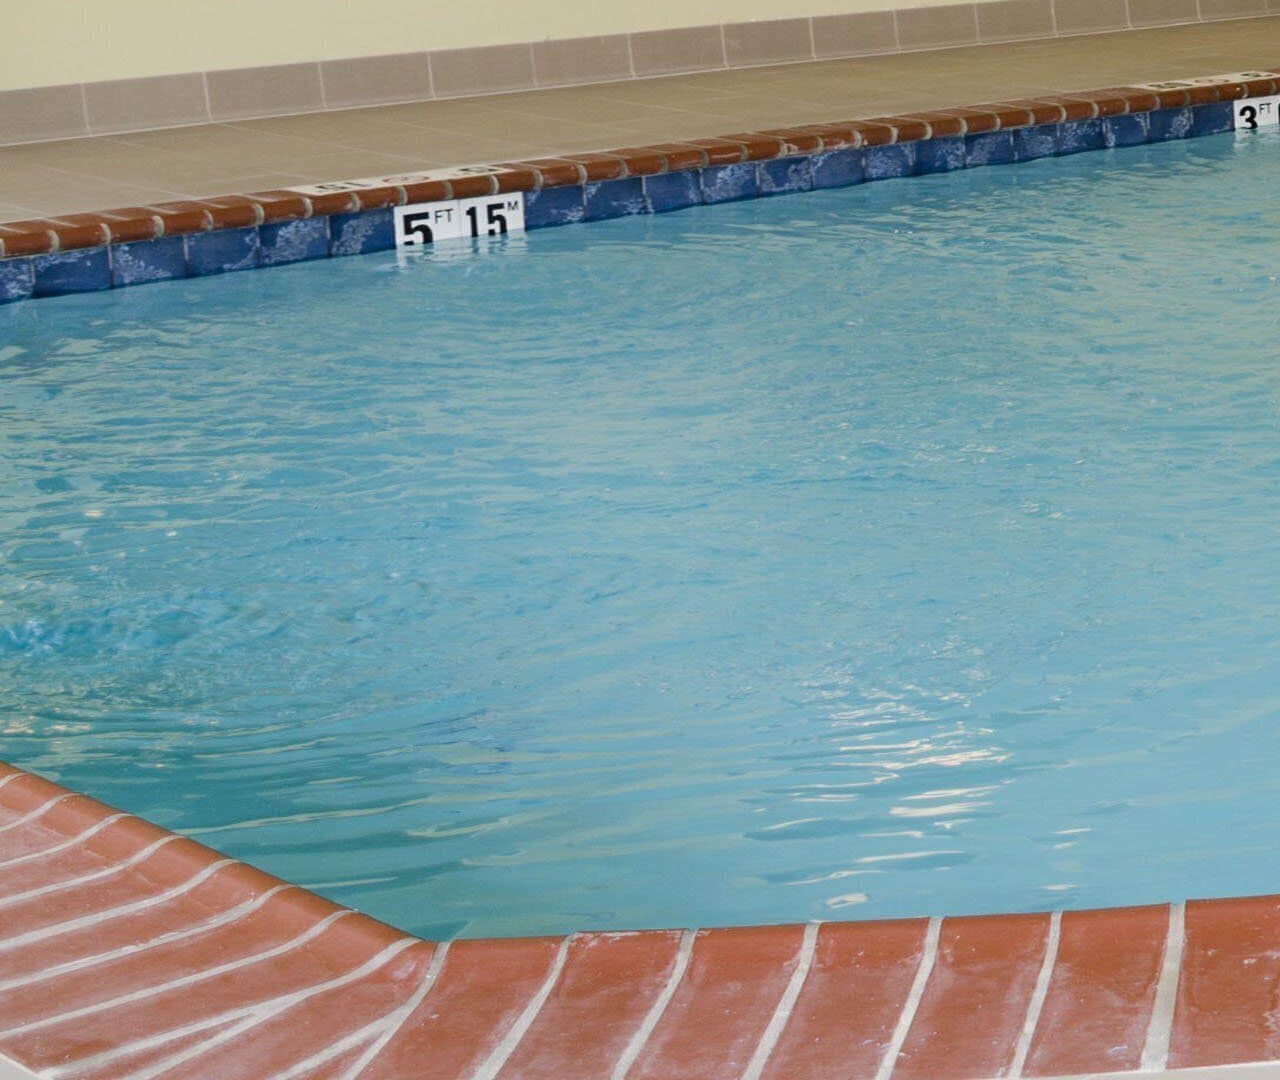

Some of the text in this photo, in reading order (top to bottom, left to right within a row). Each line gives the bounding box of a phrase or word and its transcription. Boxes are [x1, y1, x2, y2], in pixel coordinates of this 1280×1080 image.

[1238, 104, 1258, 130] 3
[1259, 102, 1273, 114] FT
[402, 211, 434, 246] 5
[434, 208, 454, 225] FT
[508, 200, 519, 211] M
